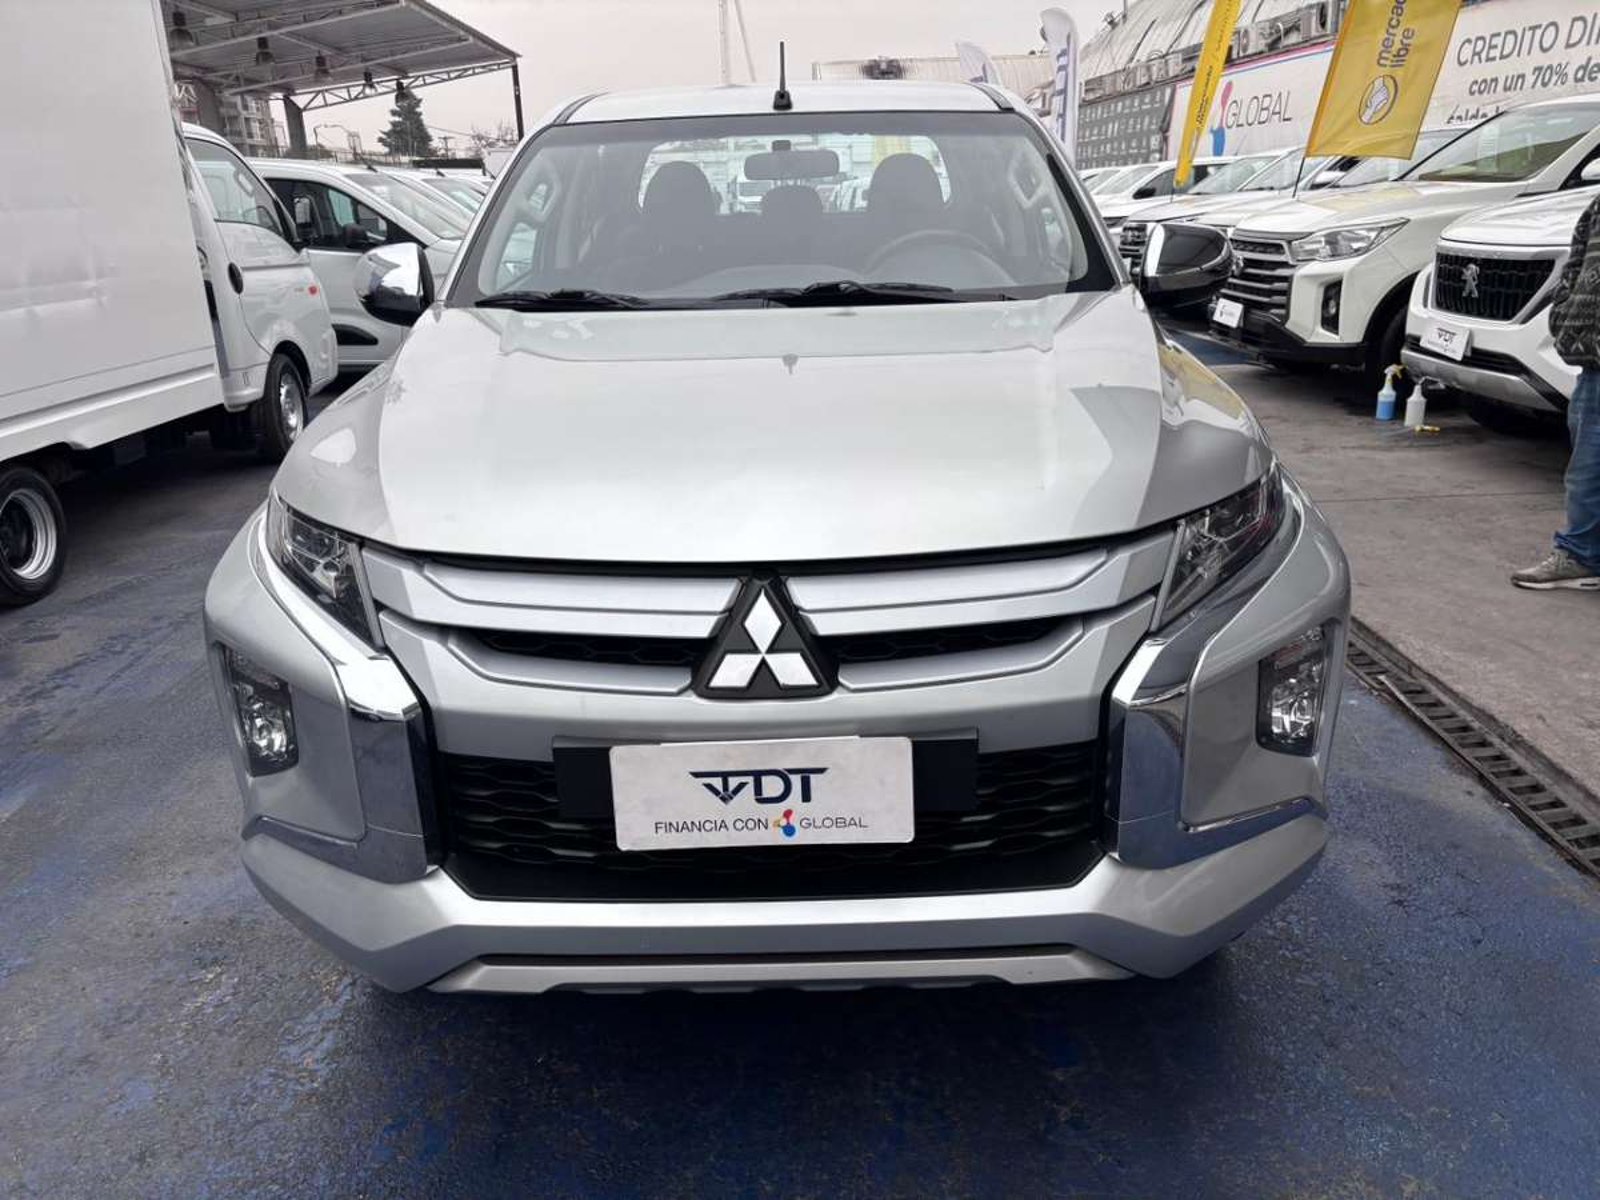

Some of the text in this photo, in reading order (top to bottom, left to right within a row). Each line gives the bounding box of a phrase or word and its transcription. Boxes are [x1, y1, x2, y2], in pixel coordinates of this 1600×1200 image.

[1390, 27, 1415, 68] libre
[1457, 21, 1560, 66] CREDITO
[1468, 56, 1600, 96] con un 70% de
[1226, 91, 1293, 129] GLOBAL
[654, 816, 869, 835] FINANCIA CON GLOBAL
